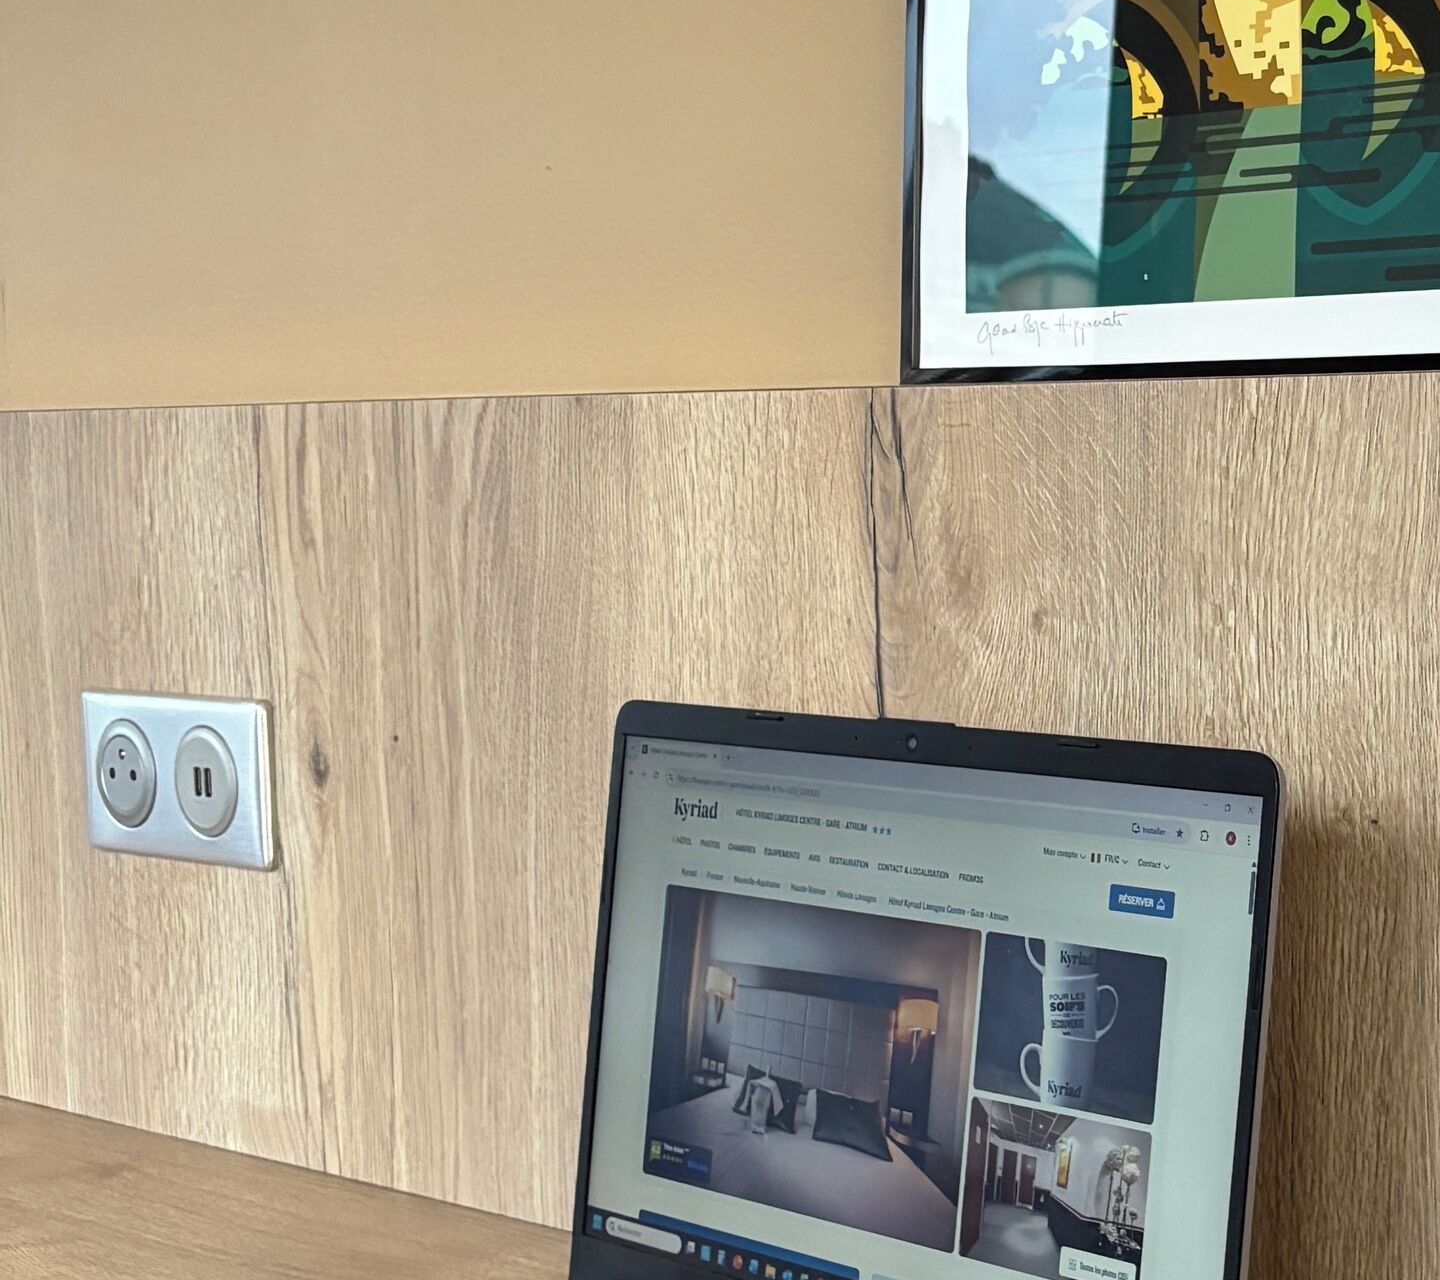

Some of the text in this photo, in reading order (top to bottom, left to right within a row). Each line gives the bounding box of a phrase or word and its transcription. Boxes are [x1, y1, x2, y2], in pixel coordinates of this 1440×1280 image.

[674, 797, 718, 822] Kyriad
[877, 862, 904, 874] CONTACT
[1118, 893, 1154, 908] RÉSERVER
[1047, 1080, 1082, 1098] Kyriad
